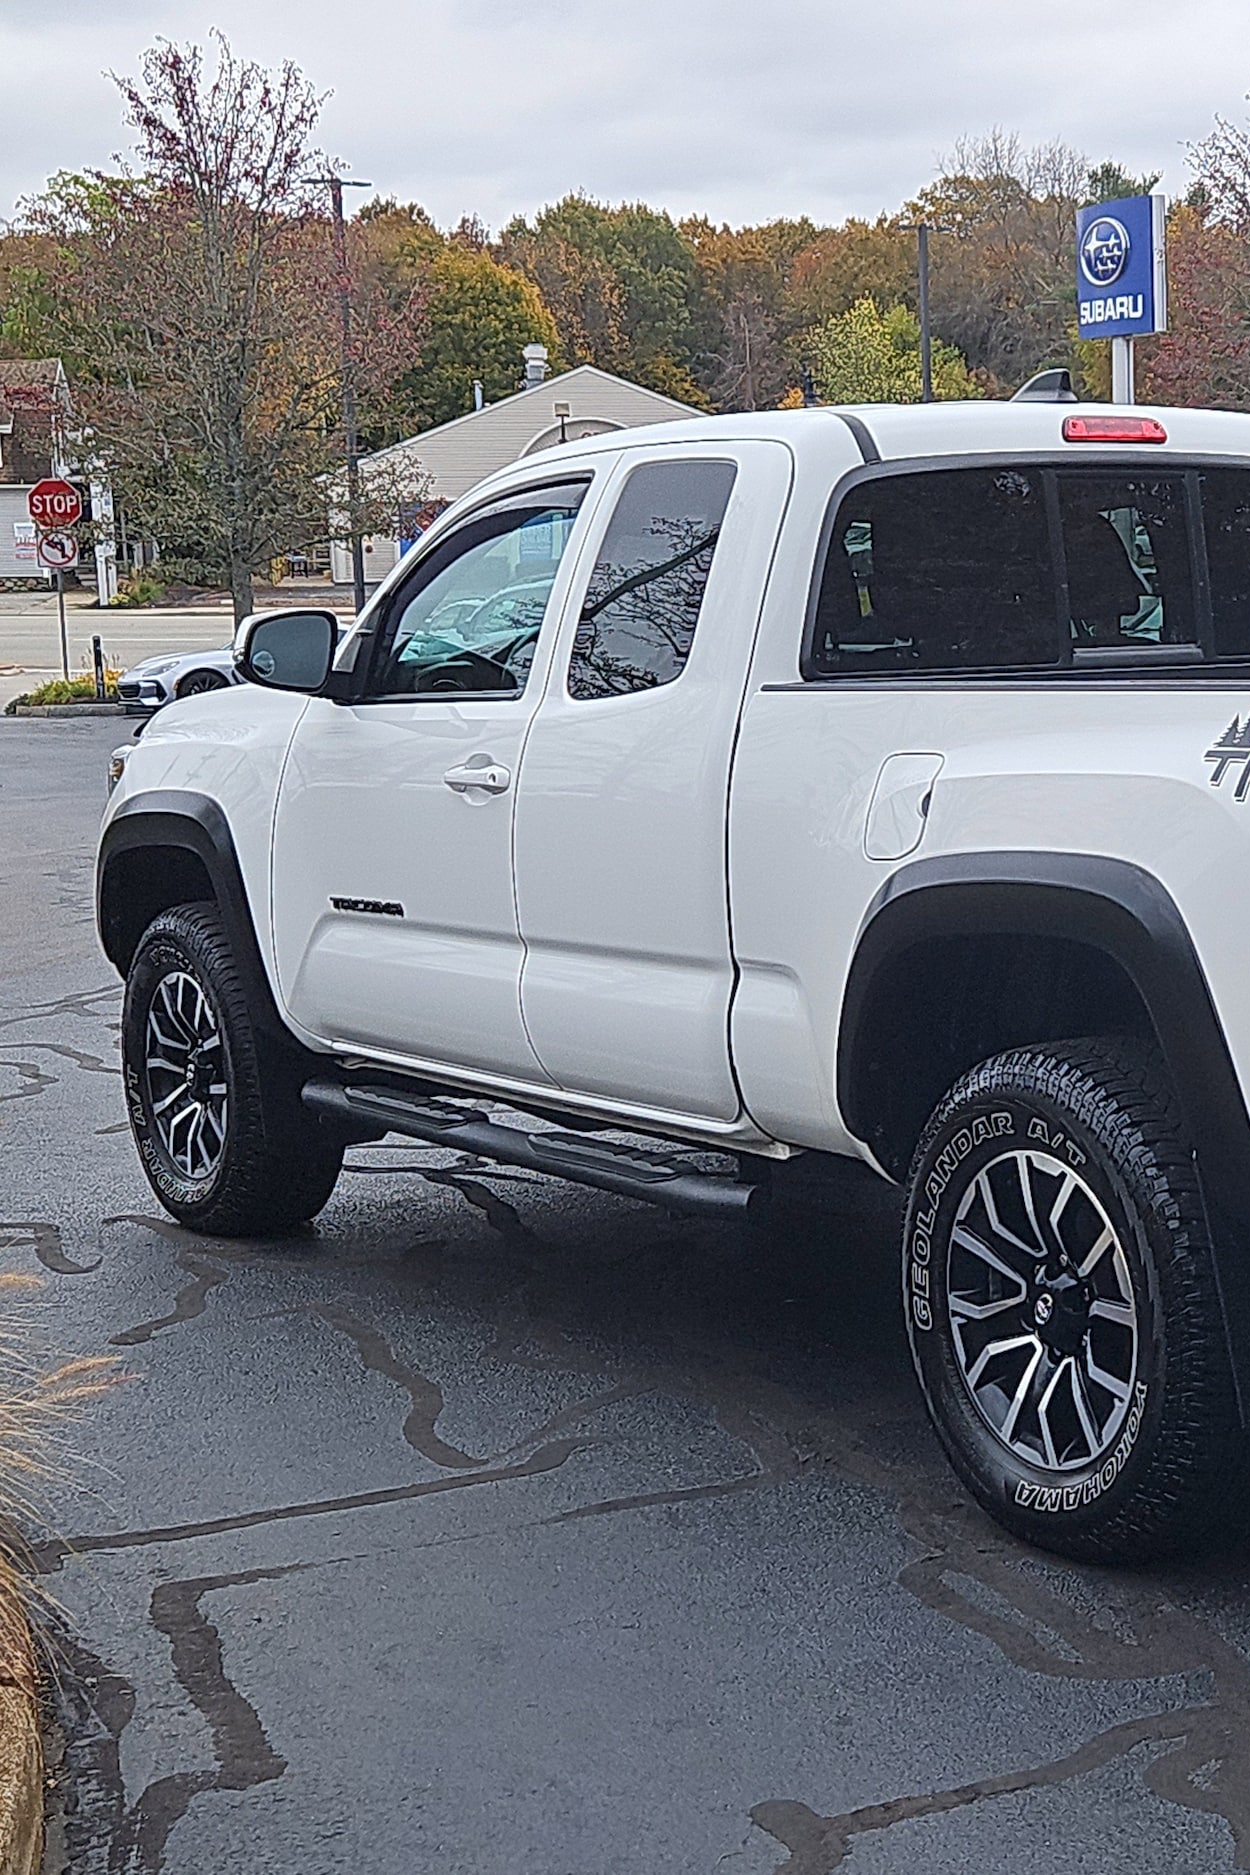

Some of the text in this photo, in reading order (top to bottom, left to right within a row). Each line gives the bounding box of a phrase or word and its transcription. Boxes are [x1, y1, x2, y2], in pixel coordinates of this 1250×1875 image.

[1080, 294, 1143, 325] SUBARU
[32, 494, 77, 514] STOP
[911, 1111, 1088, 1331] GEOLANDAR A/T
[1014, 1380, 1149, 1513] YOKOHAMA
